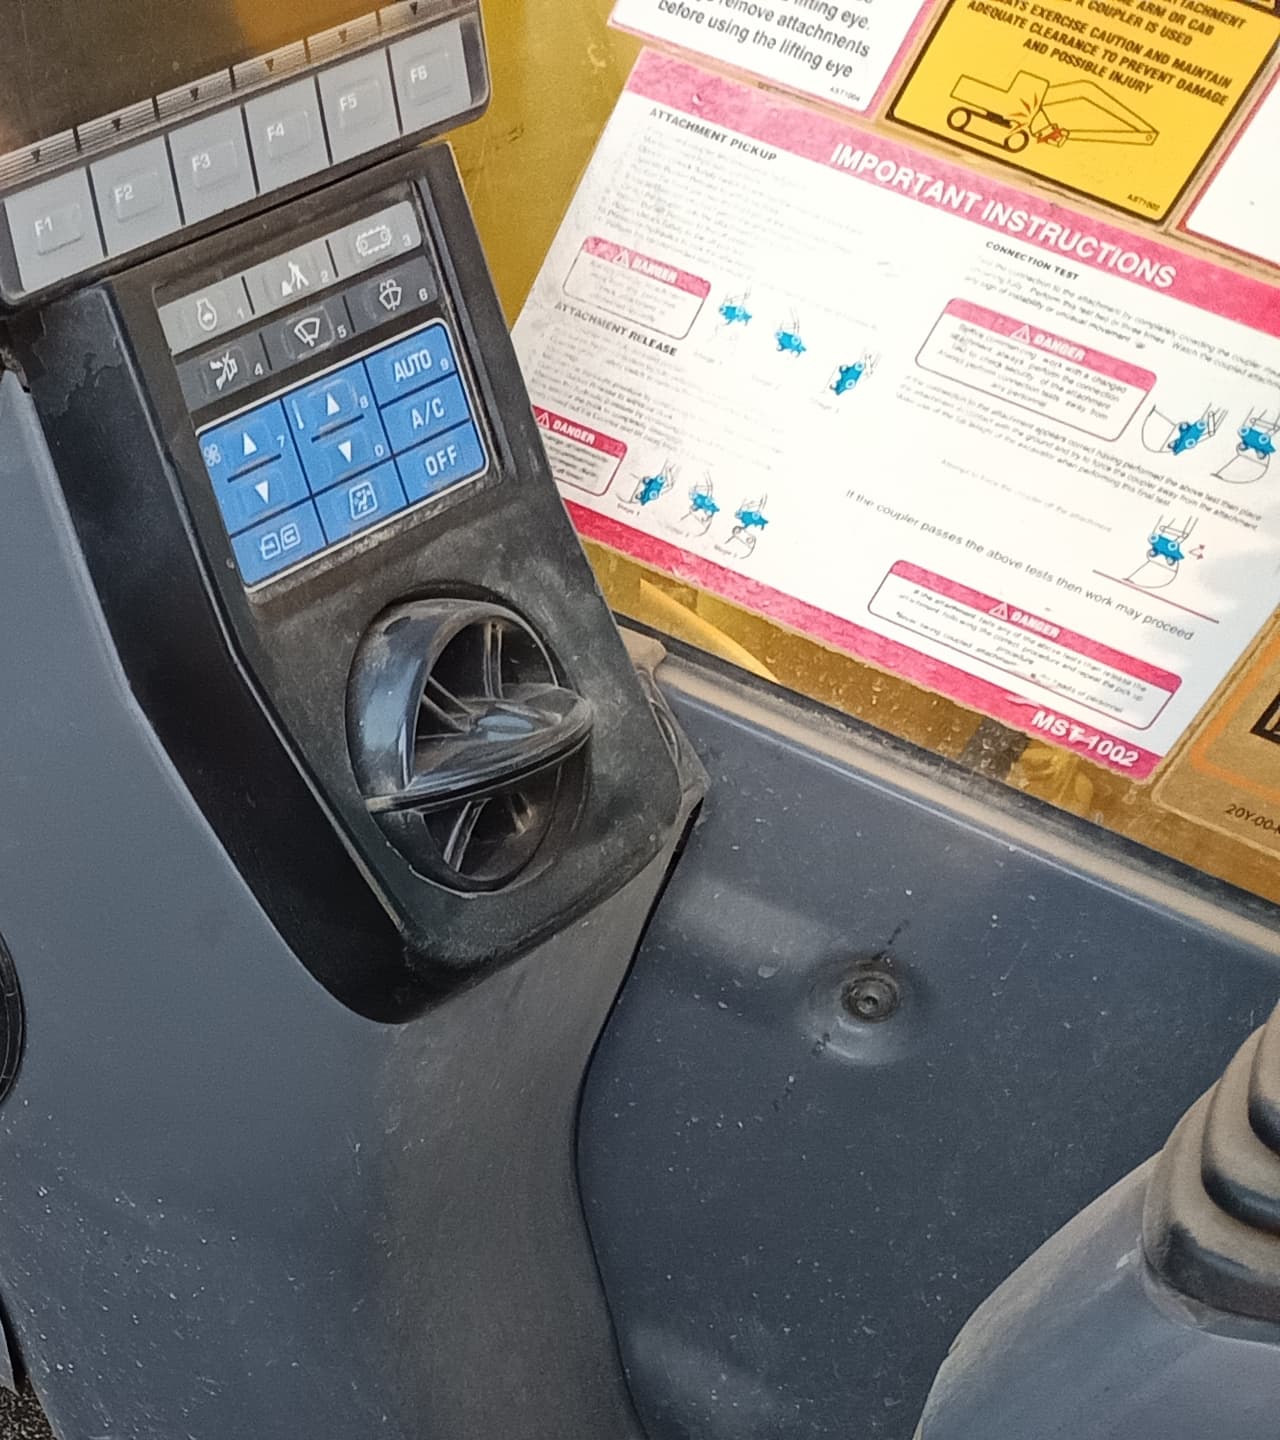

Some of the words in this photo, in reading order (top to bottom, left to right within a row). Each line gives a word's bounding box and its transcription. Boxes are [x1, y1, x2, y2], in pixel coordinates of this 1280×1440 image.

[1087, 0, 1143, 27] COUPLER
[1144, 20, 1159, 33] IS
[1159, 25, 1192, 46] USED
[1136, 0, 1166, 17] ARM
[1168, 11, 1186, 25] OR
[1187, 18, 1214, 35] CAB
[707, 16, 750, 43] using
[752, 29, 776, 49] the
[778, 38, 823, 70] lifting
[825, 59, 852, 77] eye
[776, 14, 870, 57] attachments
[1030, 4, 1088, 34] EXERCISE
[1089, 26, 1143, 54] CAUTION
[1144, 48, 1170, 64] AND
[1171, 58, 1232, 88] MAINTAIN
[967, 0, 1028, 28] ADEQUATE
[1029, 22, 1099, 56] CLEARANCE
[1101, 48, 1118, 63] TO
[1118, 56, 1175, 84] PREVENT
[1175, 78, 1228, 106] DAMAGE
[1022, 38, 1048, 54] AND
[1050, 47, 1108, 77] POSSIBLE
[1108, 70, 1153, 94] INJURY
[410, 64, 428, 83] F6
[339, 93, 358, 113] F5
[267, 122, 286, 142] F4
[649, 107, 728, 143] ATTACHMENT
[729, 138, 776, 160] PICKUP
[191, 153, 211, 172] F3
[114, 184, 134, 204] F2
[34, 217, 53, 238] F1
[828, 142, 982, 212] IMPORTANT
[981, 199, 1176, 287] INSTRUCTIONS
[403, 234, 412, 247] 3
[985, 241, 1051, 270] CONNECTION
[1054, 265, 1079, 280] TEST
[320, 271, 330, 283] 2
[419, 289, 428, 301] 6
[237, 307, 245, 318] 1
[554, 300, 628, 335] ATTACHMENT
[628, 330, 677, 356] RELEASE
[337, 325, 346, 338] 5
[1033, 334, 1084, 360] DANGER
[253, 364, 264, 377] 4
[393, 349, 432, 383] AUTO
[410, 398, 447, 429] A/C
[552, 419, 595, 444] DANGER
[424, 445, 458, 477] OFF
[876, 504, 919, 526] coupler
[919, 522, 963, 544] passes
[965, 539, 984, 553] the
[985, 549, 1023, 569] above
[1025, 564, 1053, 582] tests
[1056, 577, 1082, 594] then
[1085, 590, 1113, 606] work
[1114, 603, 1142, 620] may
[1141, 615, 1195, 640] proceed
[1010, 611, 1060, 637] DANGER
[1030, 709, 1138, 766] MST-1002
